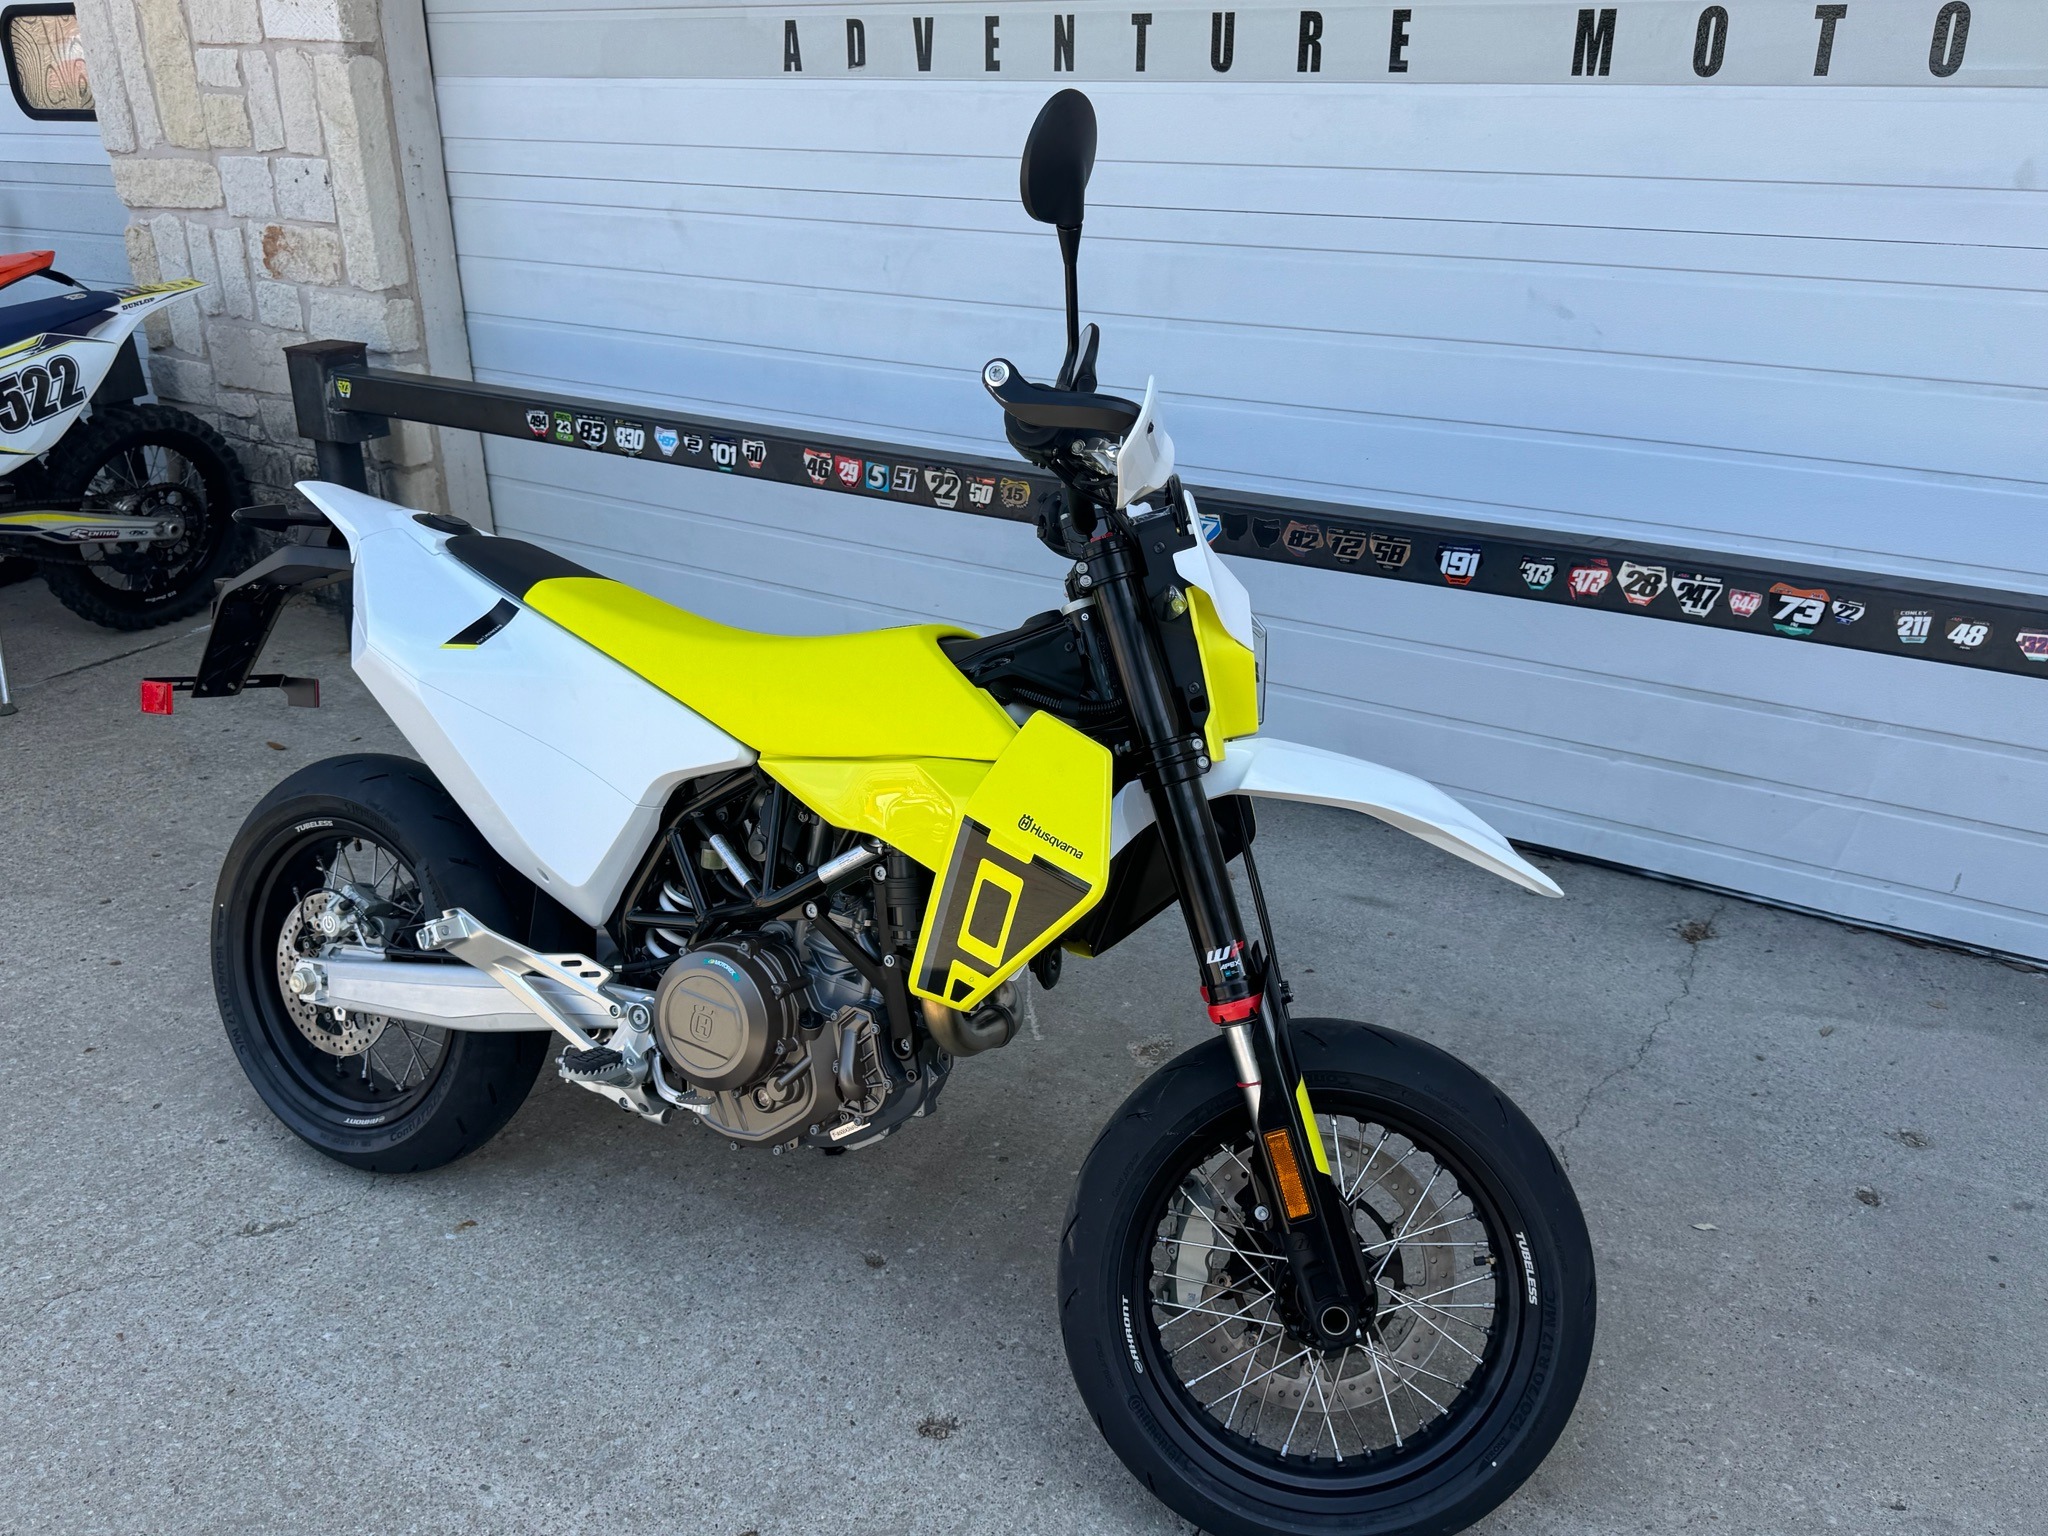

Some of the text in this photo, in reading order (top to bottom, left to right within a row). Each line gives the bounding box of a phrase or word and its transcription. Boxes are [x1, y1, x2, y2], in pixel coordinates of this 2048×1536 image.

[783, 0, 1971, 78] ADVENTURE MOTO
[121, 297, 155, 310] DUNLOP
[0, 354, 88, 434] 522
[556, 419, 572, 434] 23
[579, 420, 606, 442] 83
[615, 426, 646, 450] 830
[709, 442, 738, 466] 101
[746, 444, 764, 462] 50
[806, 457, 831, 478] 46
[839, 461, 860, 483] 29
[869, 465, 886, 488] 5
[891, 465, 919, 493] 51
[930, 474, 958, 501] 22
[968, 482, 995, 505] 50
[1006, 486, 1024, 501] 15
[1287, 529, 1320, 549] 82
[1330, 535, 1364, 557] 12
[1374, 541, 1408, 564] 58
[1440, 550, 1481, 578] 191
[1569, 569, 1609, 593] 373
[1622, 569, 1663, 598] 28
[1677, 581, 1722, 611] 247
[1772, 594, 1826, 625] 73
[1834, 603, 1861, 621] 22
[1897, 616, 1933, 636] 211
[1946, 622, 1989, 647] 48
[294, 819, 334, 833] TUBELESS
[1030, 823, 1084, 861] Husqvarna
[1206, 939, 1245, 965] WP
[1219, 959, 1242, 971] APEX
[1515, 1231, 1538, 1306] TUBELESS
[1508, 1371, 1546, 1432] 120/70
